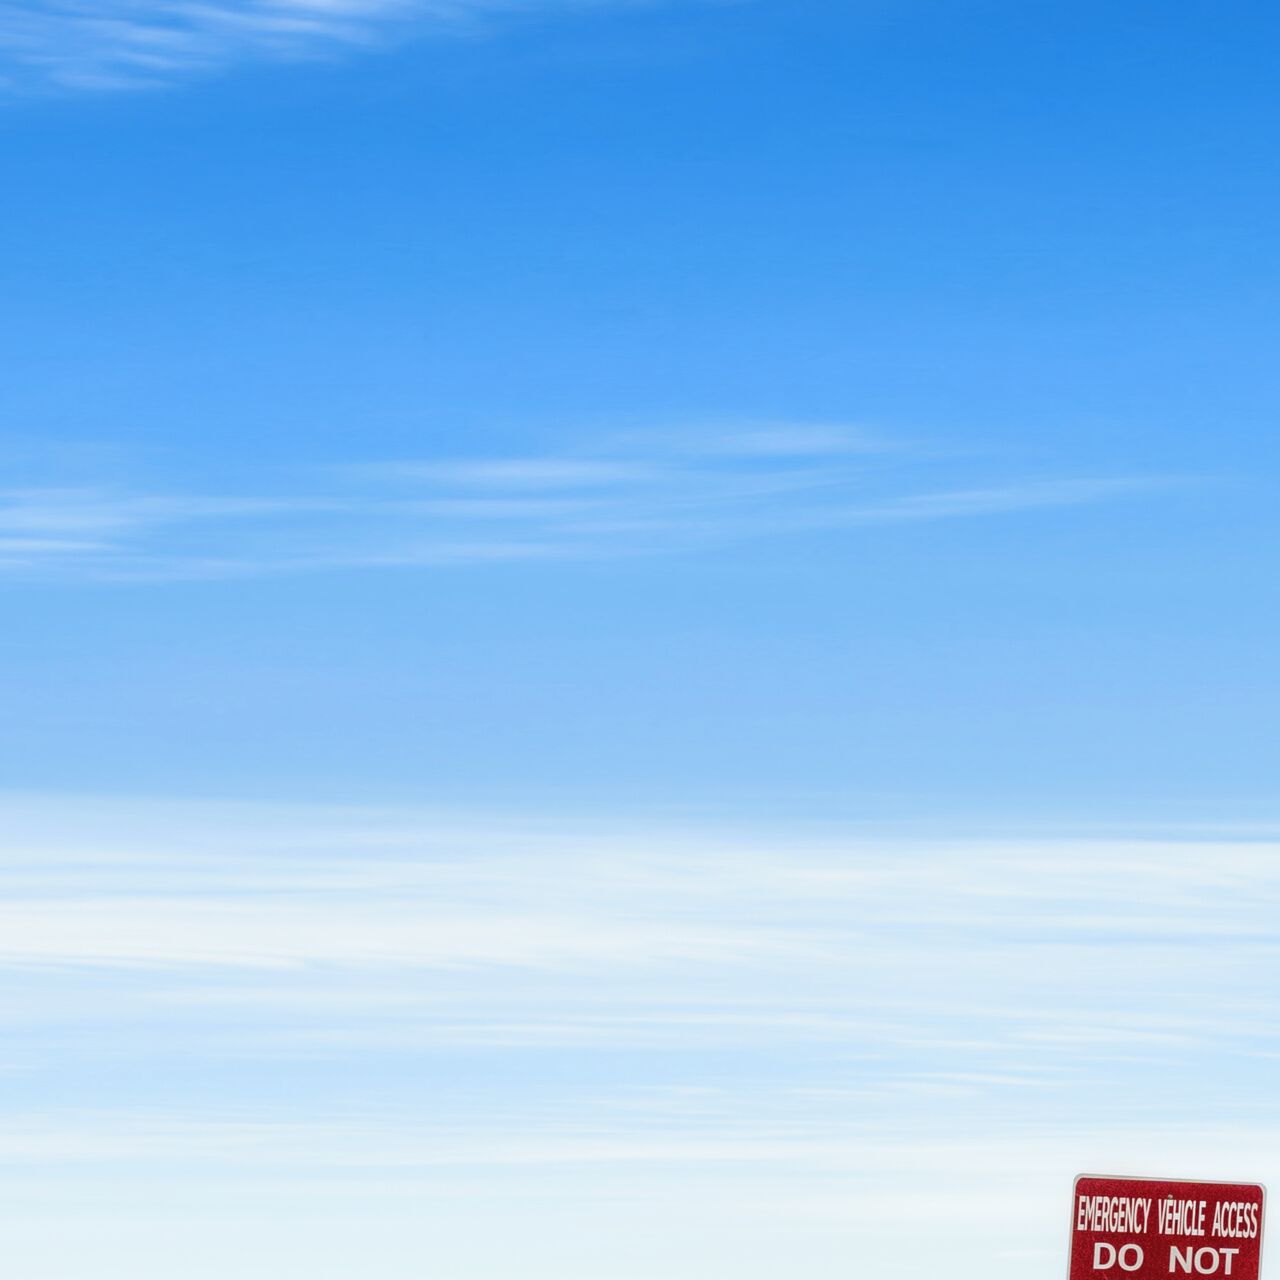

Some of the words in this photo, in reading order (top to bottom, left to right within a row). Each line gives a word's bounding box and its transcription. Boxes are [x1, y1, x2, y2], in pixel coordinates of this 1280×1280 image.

[1077, 1196, 1152, 1234] EMERGENCY
[1158, 1198, 1206, 1236] VEHICLE
[1211, 1201, 1258, 1239] ACCESS
[1092, 1242, 1144, 1271] DO
[1168, 1246, 1239, 1275] NOT
